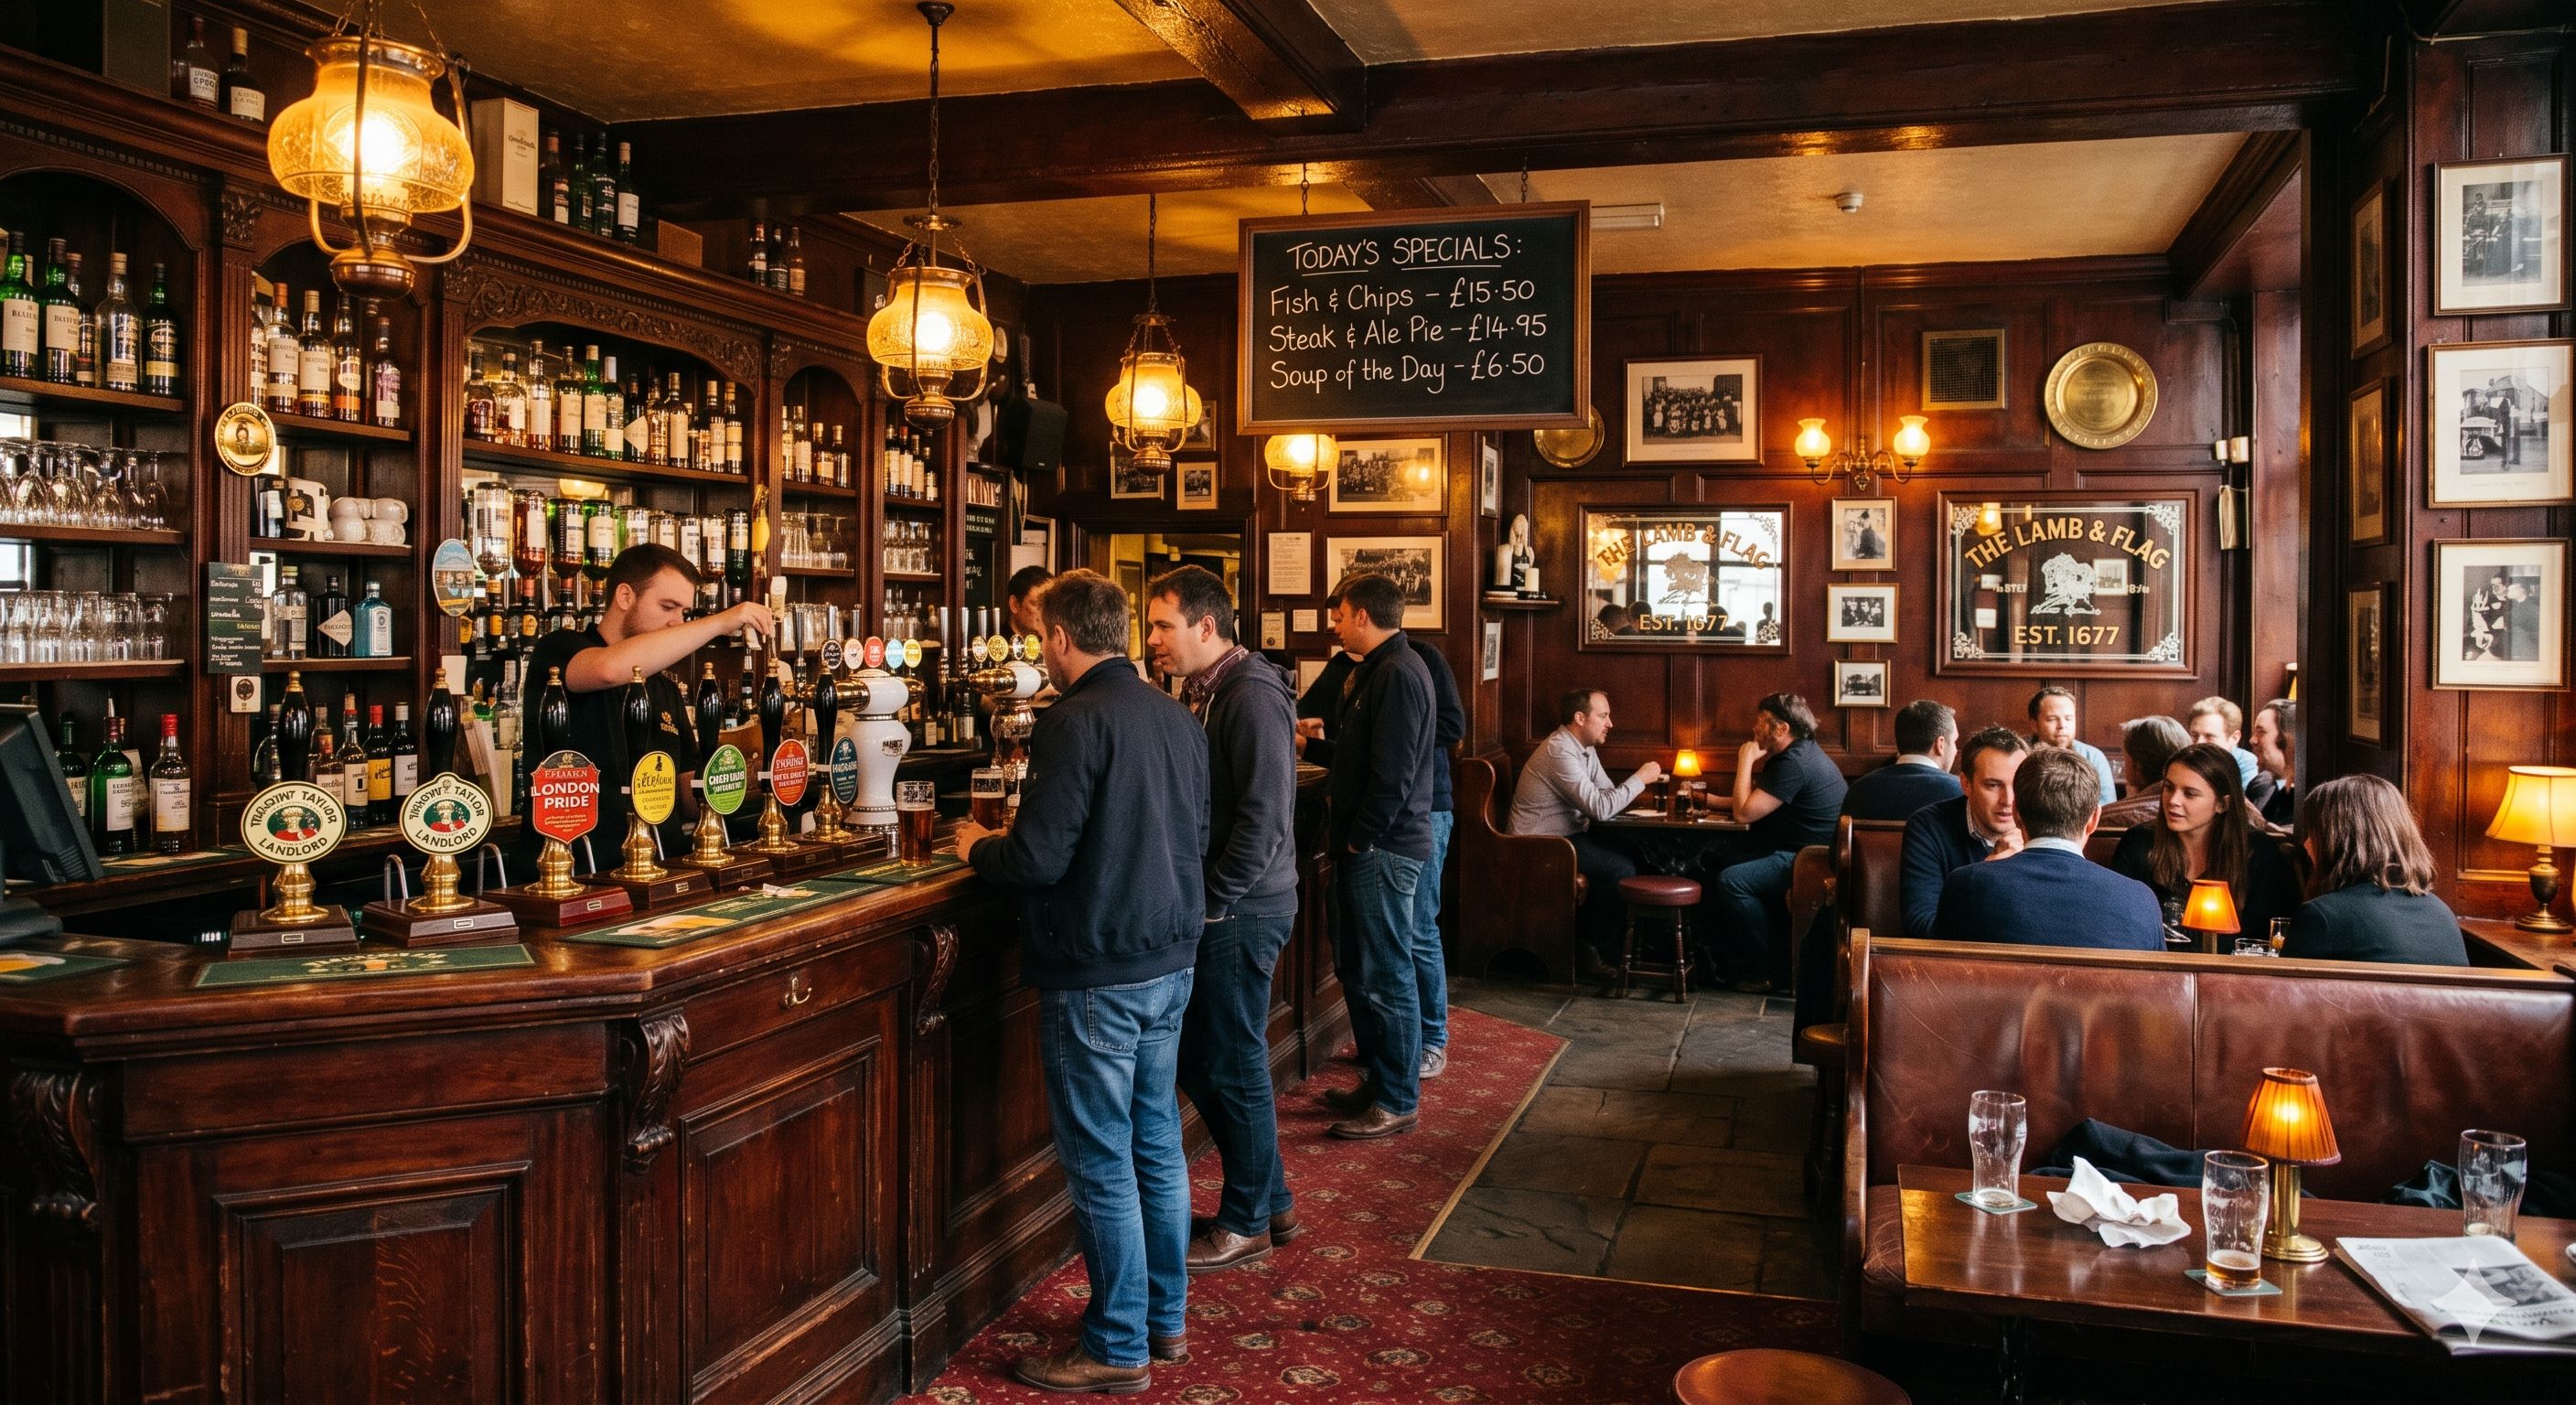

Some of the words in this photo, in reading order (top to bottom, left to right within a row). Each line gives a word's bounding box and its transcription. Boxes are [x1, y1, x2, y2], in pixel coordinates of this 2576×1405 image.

[1286, 240, 1379, 270] TODAY'S
[1271, 285, 1319, 316] Fish
[1329, 289, 1339, 313] &
[1347, 284, 1413, 316] Chips
[1269, 324, 1336, 352] Steak
[1347, 323, 1356, 349] &
[1364, 319, 1401, 346] Ale
[1410, 315, 1444, 342] Pie
[1270, 361, 1328, 394] Soup
[1336, 359, 1357, 391] of
[1362, 359, 1394, 381] the
[1401, 355, 1444, 394] Day
[1596, 535, 1637, 567] THE
[1639, 523, 1697, 547] LAMB
[1701, 524, 1717, 545] &
[1964, 531, 2012, 569] THE
[2014, 517, 2084, 547] LAMB
[2088, 520, 2107, 542] &
[2109, 525, 2171, 570] FLAG
[1639, 614, 1679, 631] EST.
[1687, 614, 1728, 631] 1677
[2014, 626, 2061, 645] EST.
[2068, 626, 2120, 645] 1677
[544, 795, 589, 809] PRIDE
[258, 837, 327, 856] LANDLORD
[414, 827, 478, 848] LANDLORD
